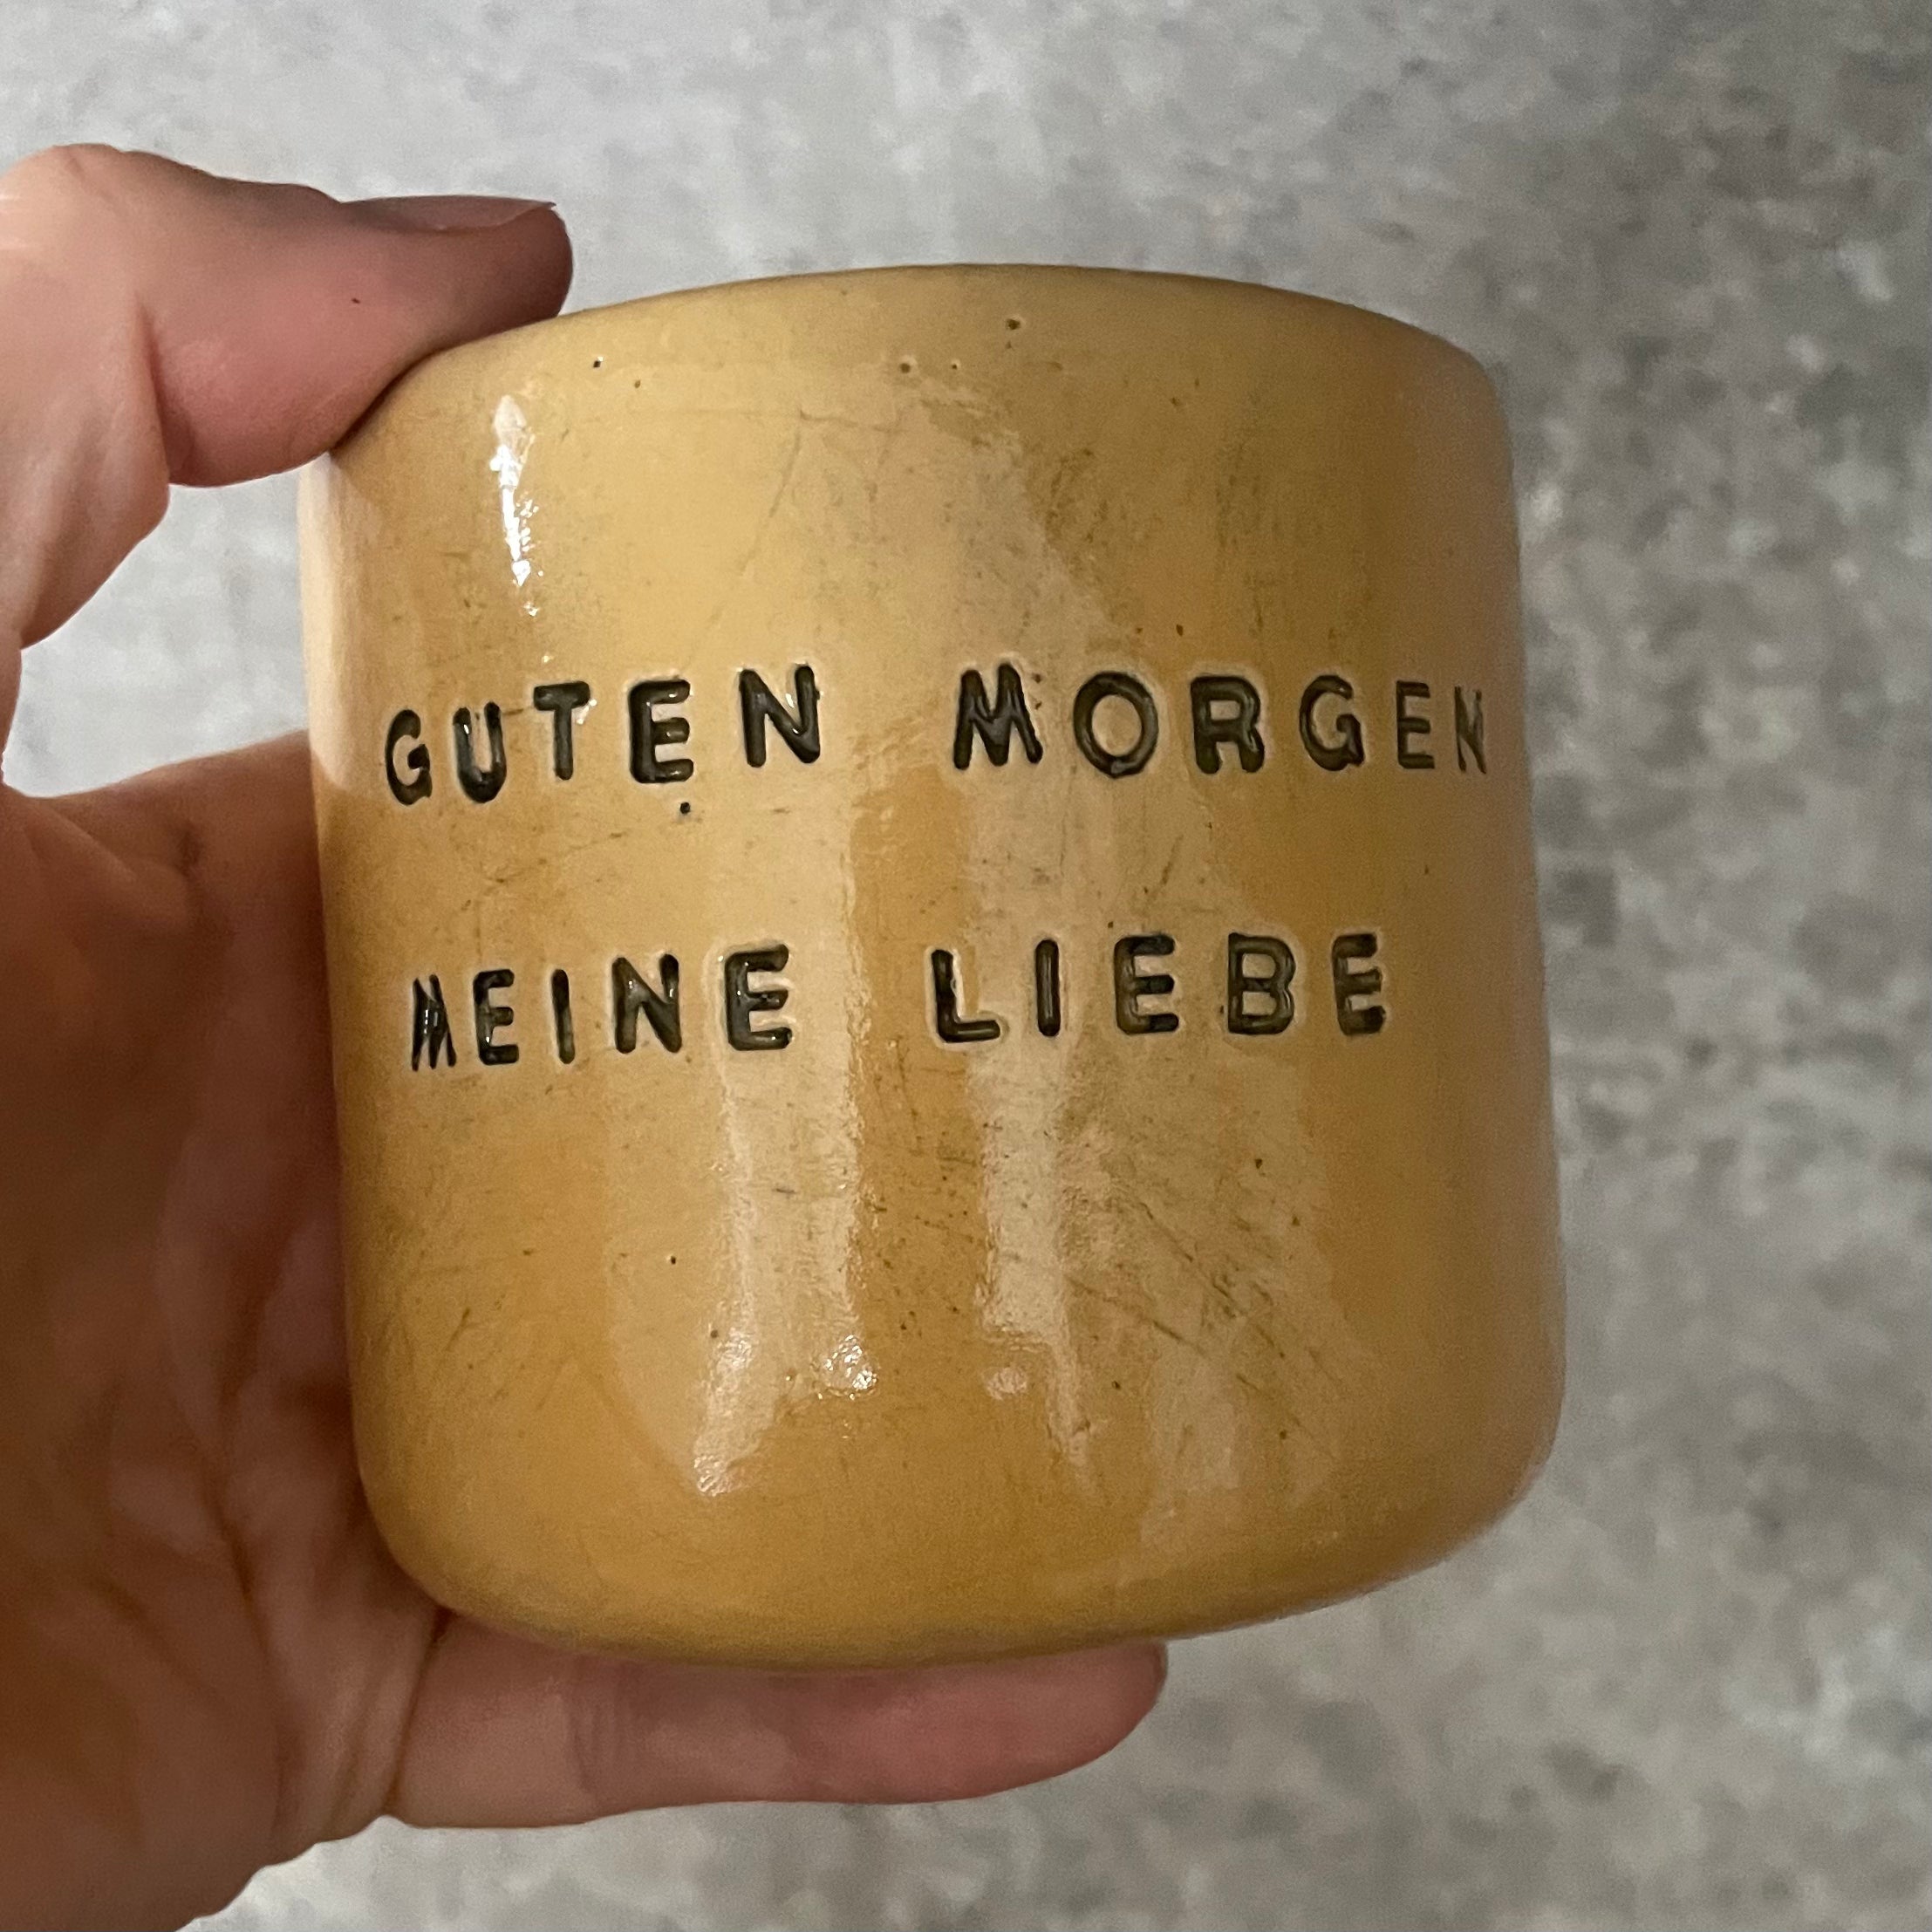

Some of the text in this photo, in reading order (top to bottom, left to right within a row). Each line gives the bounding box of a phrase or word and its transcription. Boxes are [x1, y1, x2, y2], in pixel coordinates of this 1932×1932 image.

[385, 662, 1487, 806] GUTEN MORGEN
[412, 932, 1388, 1072] MEINE LIEBE
